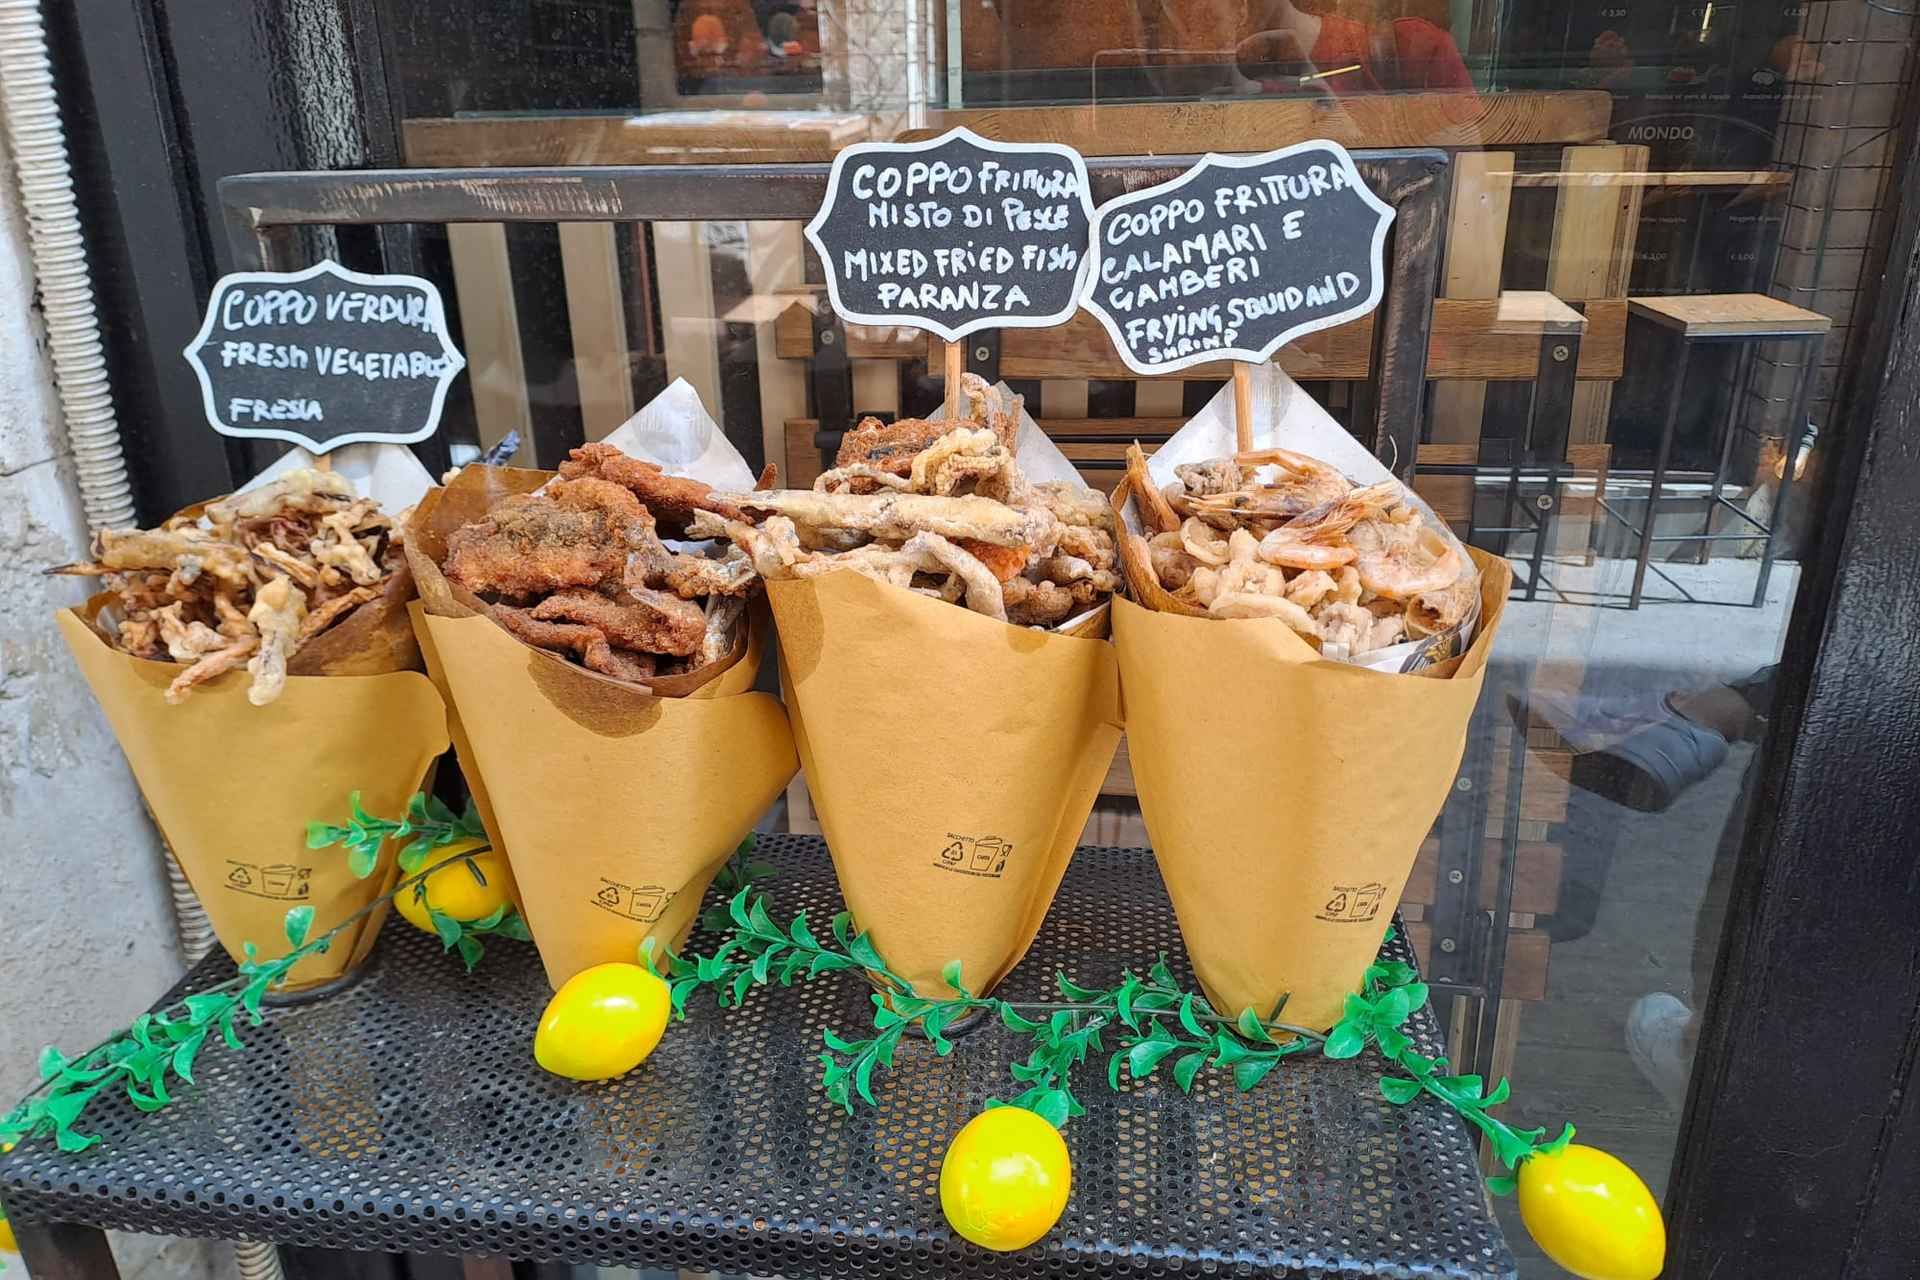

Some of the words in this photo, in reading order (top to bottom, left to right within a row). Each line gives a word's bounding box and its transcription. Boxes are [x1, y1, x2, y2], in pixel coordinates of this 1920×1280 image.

[1628, 126, 1695, 140] MONDO
[852, 161, 973, 200] COPPO
[963, 204, 993, 228] DI
[1107, 199, 1205, 246] COPPO
[1214, 162, 1352, 218] FRITTURA
[844, 248, 928, 282] MIXED
[1101, 223, 1267, 284] CALAMARI
[1282, 210, 1305, 240] E
[877, 281, 1030, 312] PARANZA
[1109, 256, 1261, 312] GAMBERI
[223, 289, 317, 331] COPPO
